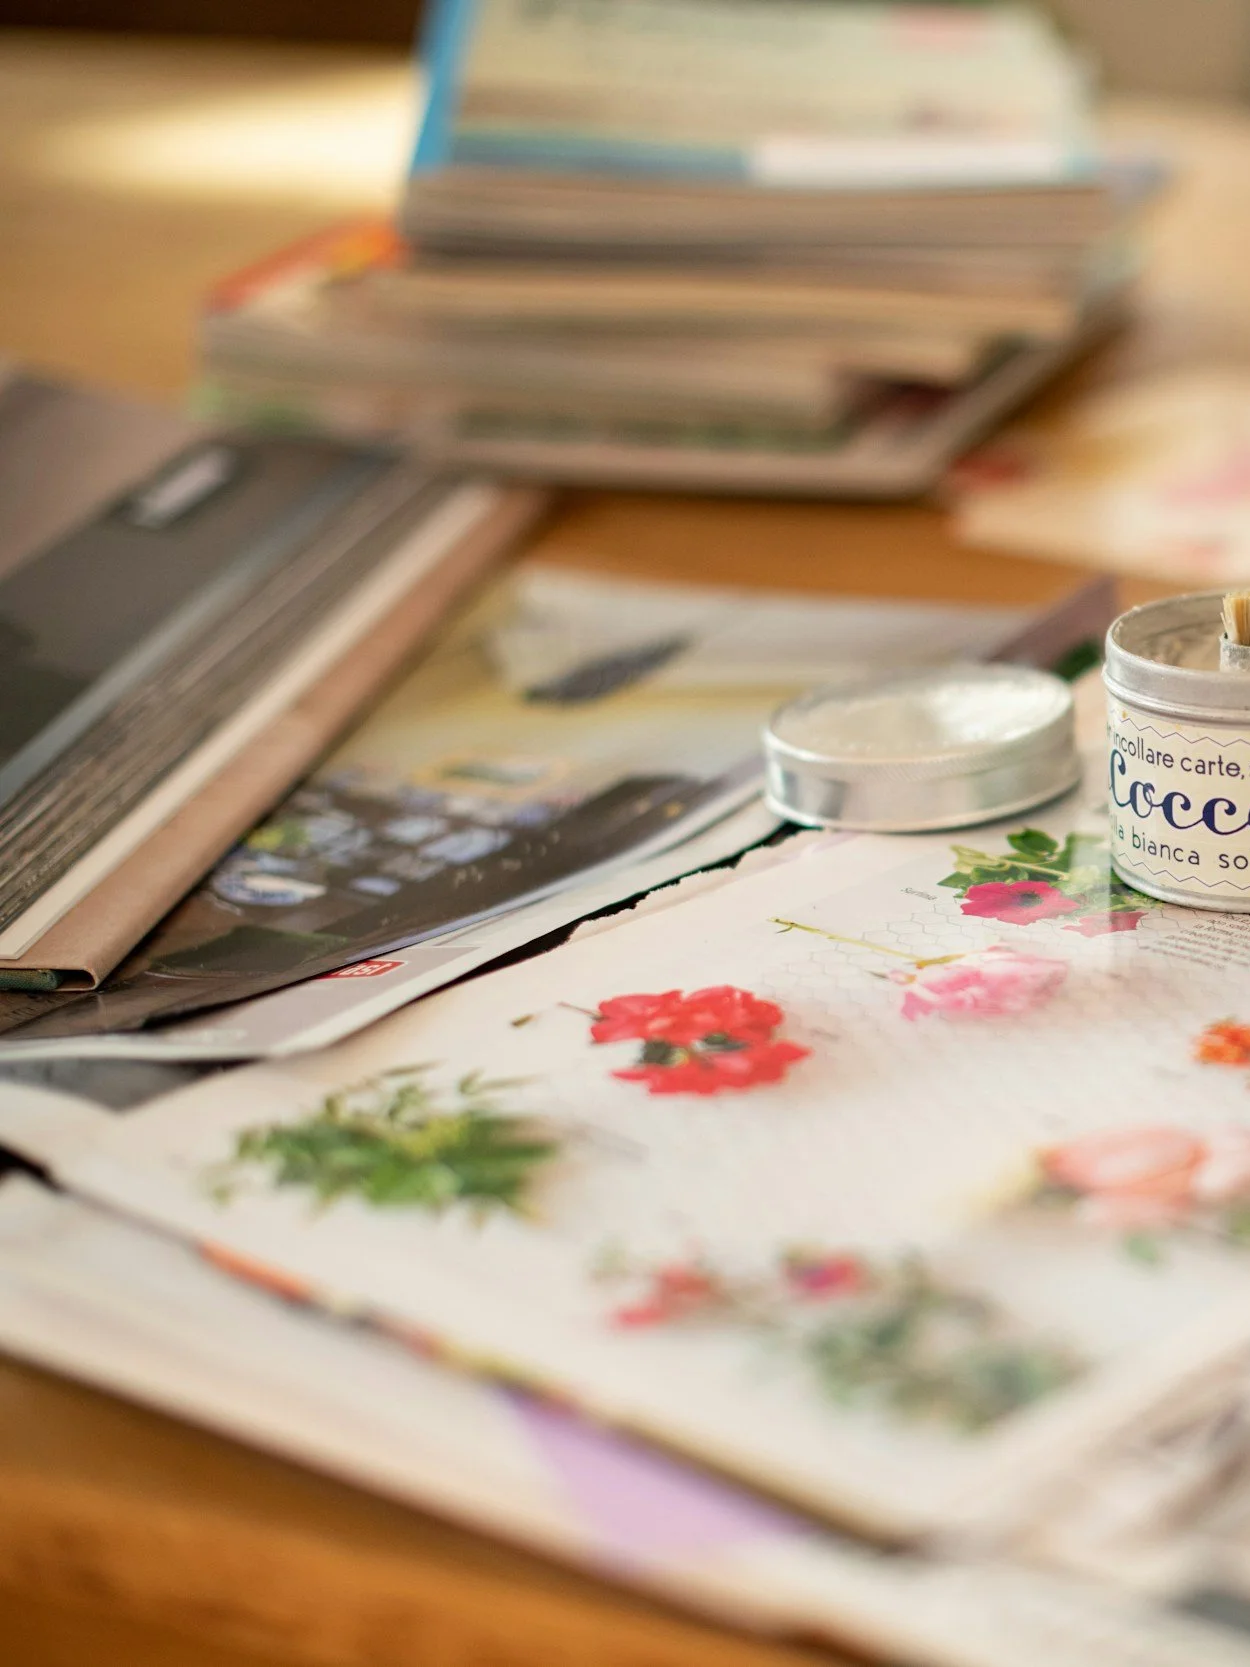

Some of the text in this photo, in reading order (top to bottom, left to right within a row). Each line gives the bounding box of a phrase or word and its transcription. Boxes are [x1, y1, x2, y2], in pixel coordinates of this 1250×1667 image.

[1113, 732, 1175, 769] incollare
[1180, 754, 1245, 780] carte,
[1132, 825, 1201, 866] bianca
